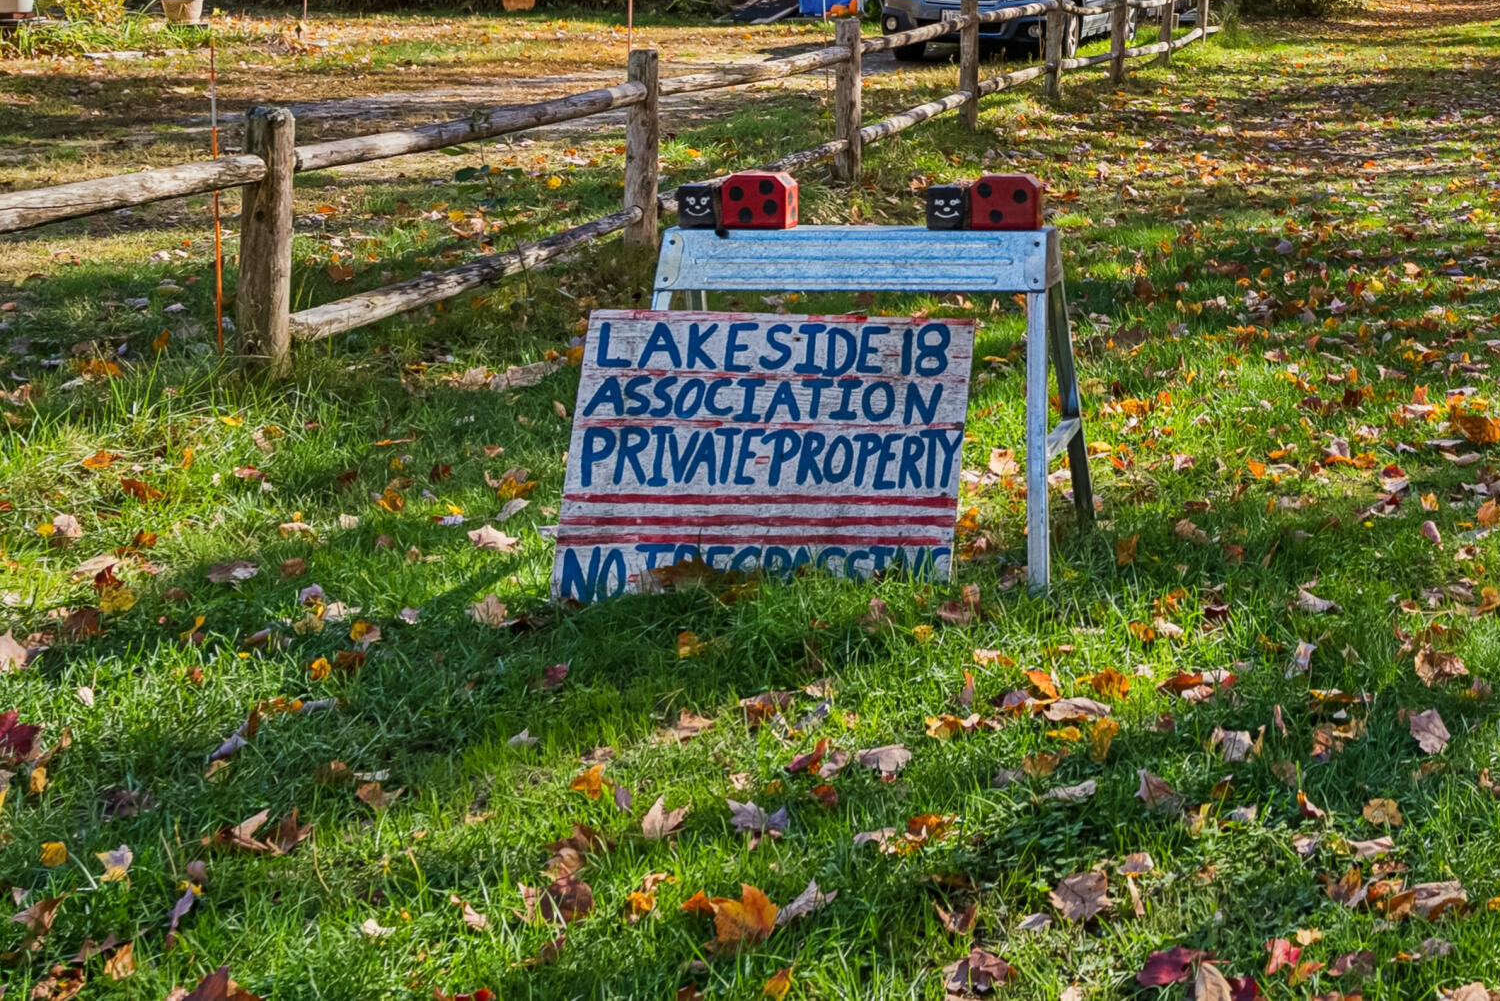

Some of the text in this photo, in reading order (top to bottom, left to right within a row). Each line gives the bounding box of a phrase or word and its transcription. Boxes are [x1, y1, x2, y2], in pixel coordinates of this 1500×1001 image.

[597, 322, 951, 377] LAKESIDE 18
[582, 375, 944, 425] ASSOCIATION
[580, 426, 964, 490] PRIVATE PROPERTY
[561, 546, 626, 604] NO
